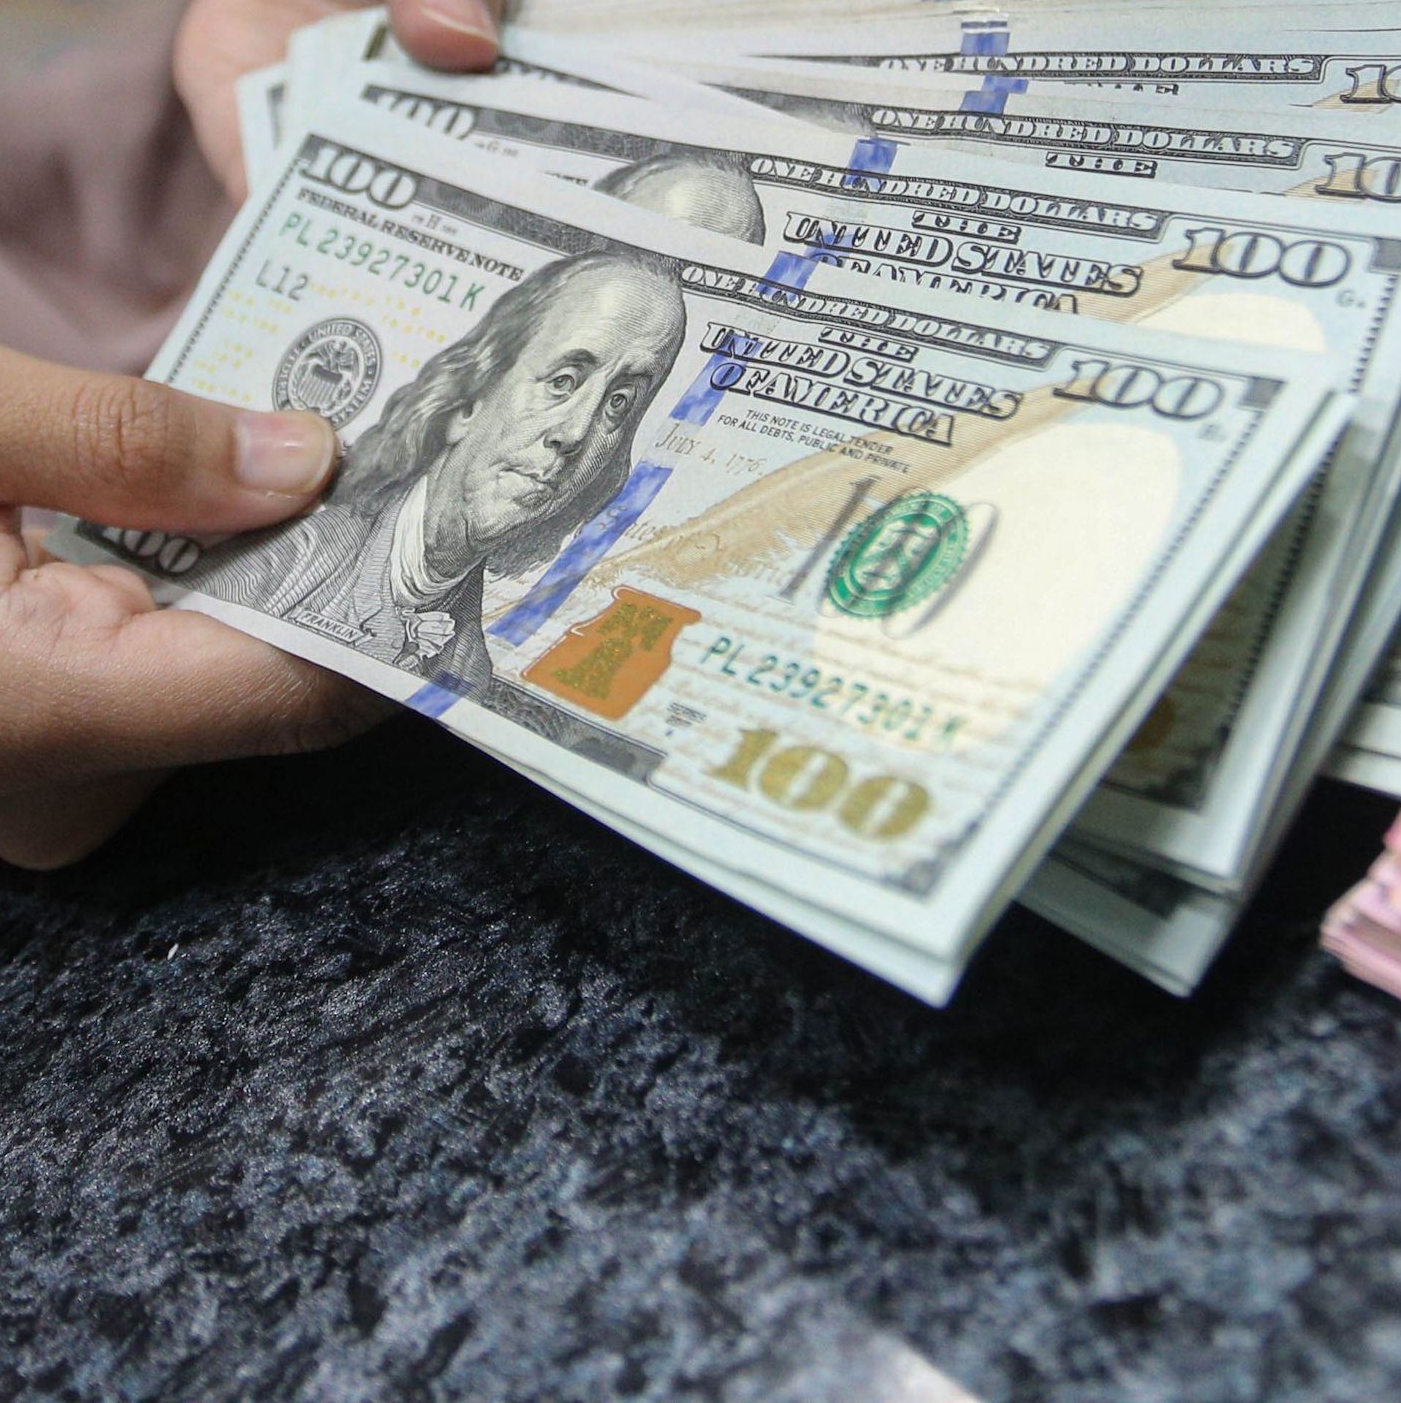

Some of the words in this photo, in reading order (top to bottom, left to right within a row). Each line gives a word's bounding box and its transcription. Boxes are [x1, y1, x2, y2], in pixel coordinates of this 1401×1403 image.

[951, 55, 1128, 75] HUNDRED
[1130, 57, 1316, 75] DOLLARS
[870, 107, 941, 131] ONE
[944, 114, 1117, 147] HUNDRED
[1118, 128, 1296, 159] DOLLARS
[297, 145, 420, 211] 100
[750, 156, 822, 185] ONE
[820, 168, 981, 208] HUNDRED
[982, 193, 1159, 231] DOLLARS
[297, 188, 380, 230] FEDERAL
[380, 216, 474, 265] RESERVE
[468, 250, 526, 283] NOTE
[783, 211, 954, 268] UNITED
[951, 241, 1144, 298] STATES
[912, 209, 1023, 246] THE
[1172, 227, 1352, 288] 100
[254, 256, 309, 301] L12
[681, 265, 740, 292] ONE
[737, 278, 889, 328] HUNDRED
[889, 312, 1053, 363] DOLLARS
[817, 326, 920, 363] THE
[699, 321, 852, 379] UNITED
[843, 355, 1024, 421] STATES
[1052, 359, 1227, 421] 100
[710, 360, 768, 398] OF
[754, 366, 957, 448] AMERICA
[746, 409, 772, 425] THIS
[771, 414, 798, 432] NOTE
[799, 422, 812, 434] IS
[812, 425, 847, 445] LEGAL
[849, 435, 895, 457] TENDER
[654, 422, 702, 457] JULY
[717, 414, 741, 429] FOR
[738, 418, 759, 434] ALL
[759, 424, 796, 444] DEBTS,
[798, 434, 839, 455] PUBLIC
[838, 445, 866, 462] AND
[864, 453, 912, 475] PRIVATE
[300, 610, 359, 641] FRANKLIN
[702, 727, 931, 838] 100
